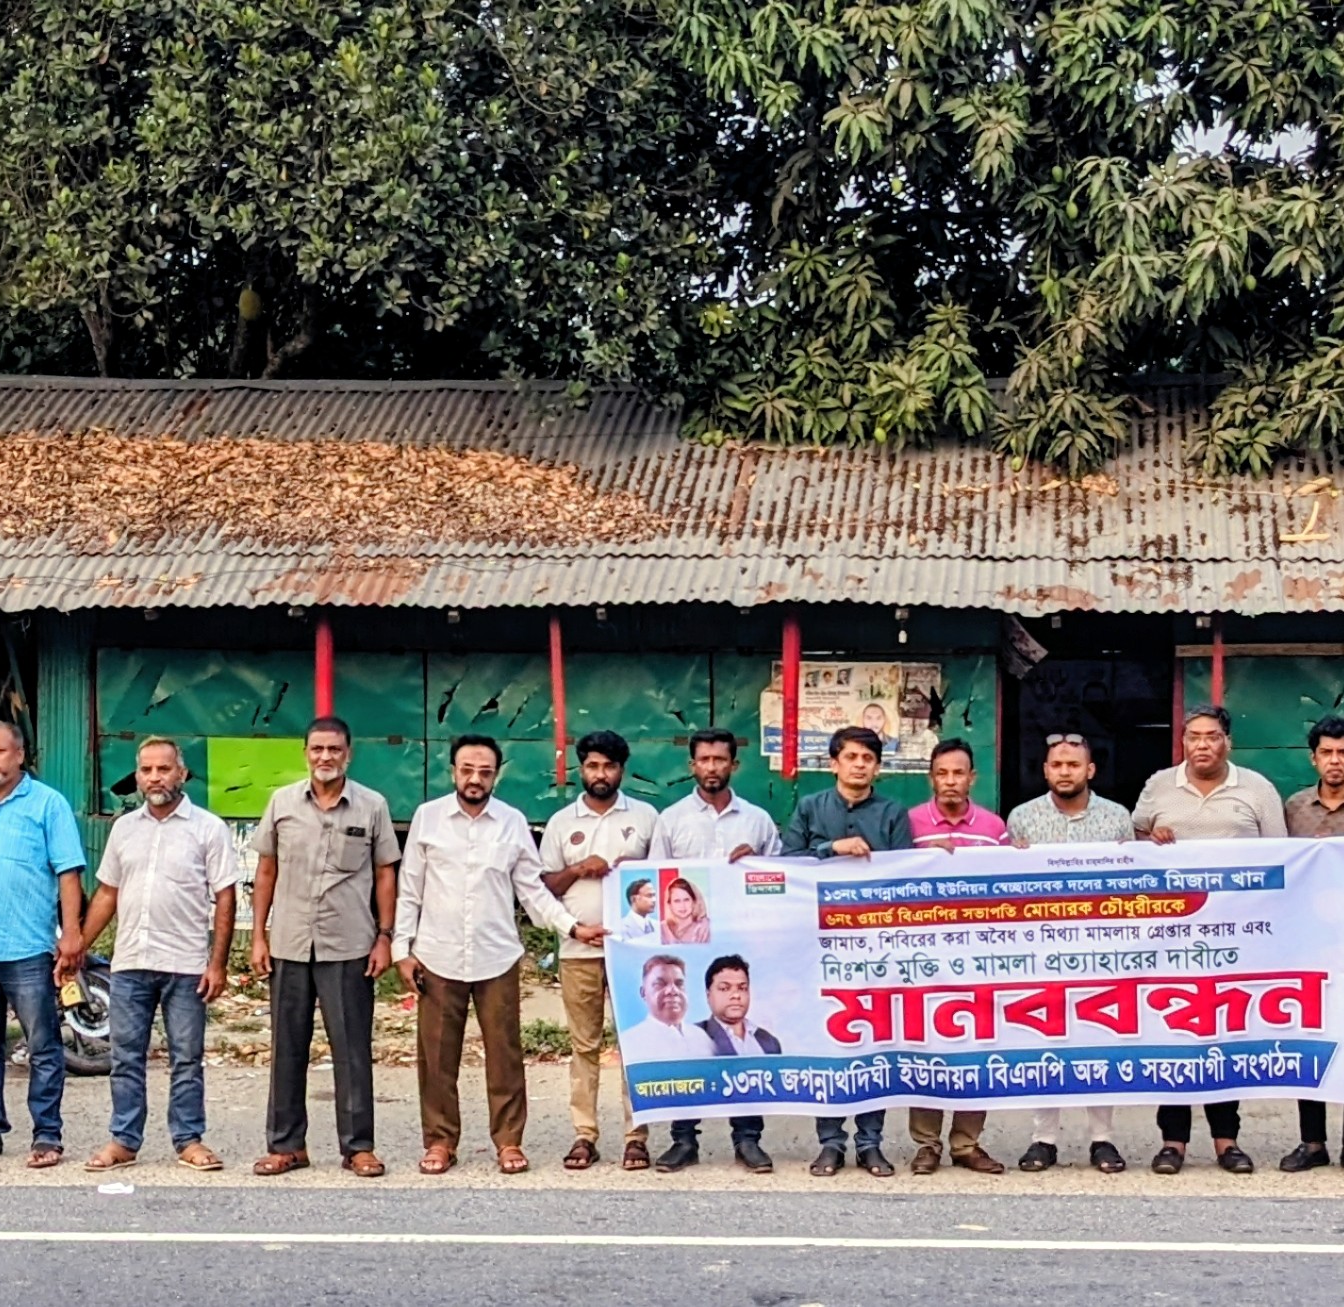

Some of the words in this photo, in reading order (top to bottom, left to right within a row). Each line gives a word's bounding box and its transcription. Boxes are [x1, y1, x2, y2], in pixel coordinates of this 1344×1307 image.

[824, 889, 857, 902] ১৩নং
[937, 881, 988, 897] ইউনিয়ন
[1067, 877, 1102, 891] দলের
[1106, 874, 1159, 890] সভাপতি
[1164, 869, 1223, 890] মিজান
[1231, 871, 1265, 887] খান
[856, 907, 894, 925] ওয়ার্ড
[898, 907, 957, 924] বিএনপির
[962, 903, 1017, 920] সভাপতি
[1023, 900, 1092, 918] মোবারক
[1099, 894, 1186, 918] চৌধুরীরকে
[818, 933, 873, 953] জামাত,
[878, 930, 936, 950] শিবিরের
[942, 930, 970, 947] করা
[975, 926, 1017, 945] অবৈধ
[1022, 930, 1035, 942] ও
[1039, 924, 1079, 943] মিথ্যা
[1085, 924, 1141, 941] মামলায়
[1147, 922, 1192, 940] গ্রেপ্তার
[1198, 920, 1236, 937] করায়
[1242, 920, 1272, 935] এবং
[821, 952, 891, 982] নিঃশর্ত
[896, 951, 940, 985] মুক্তি
[948, 959, 965, 976] ও
[973, 951, 1036, 977] মামলা
[1044, 948, 1158, 976] প্রত্যাহারের
[1165, 941, 1239, 970] দাবীতে
[820, 971, 1329, 1043] মানববন্ধন
[634, 1077, 705, 1097] আয়োজনে
[721, 1070, 776, 1097] ১৩নং
[779, 1055, 891, 1104] জগন্নাথদিঘী
[896, 1054, 981, 1091] ইউনিয়ন
[987, 1052, 1065, 1089] বিএনপি
[1070, 1059, 1110, 1087] অঙ্গ
[1116, 1061, 1134, 1082] ও
[1140, 1046, 1226, 1087] সহযোগী
[1230, 1041, 1303, 1081] সংগঠন
